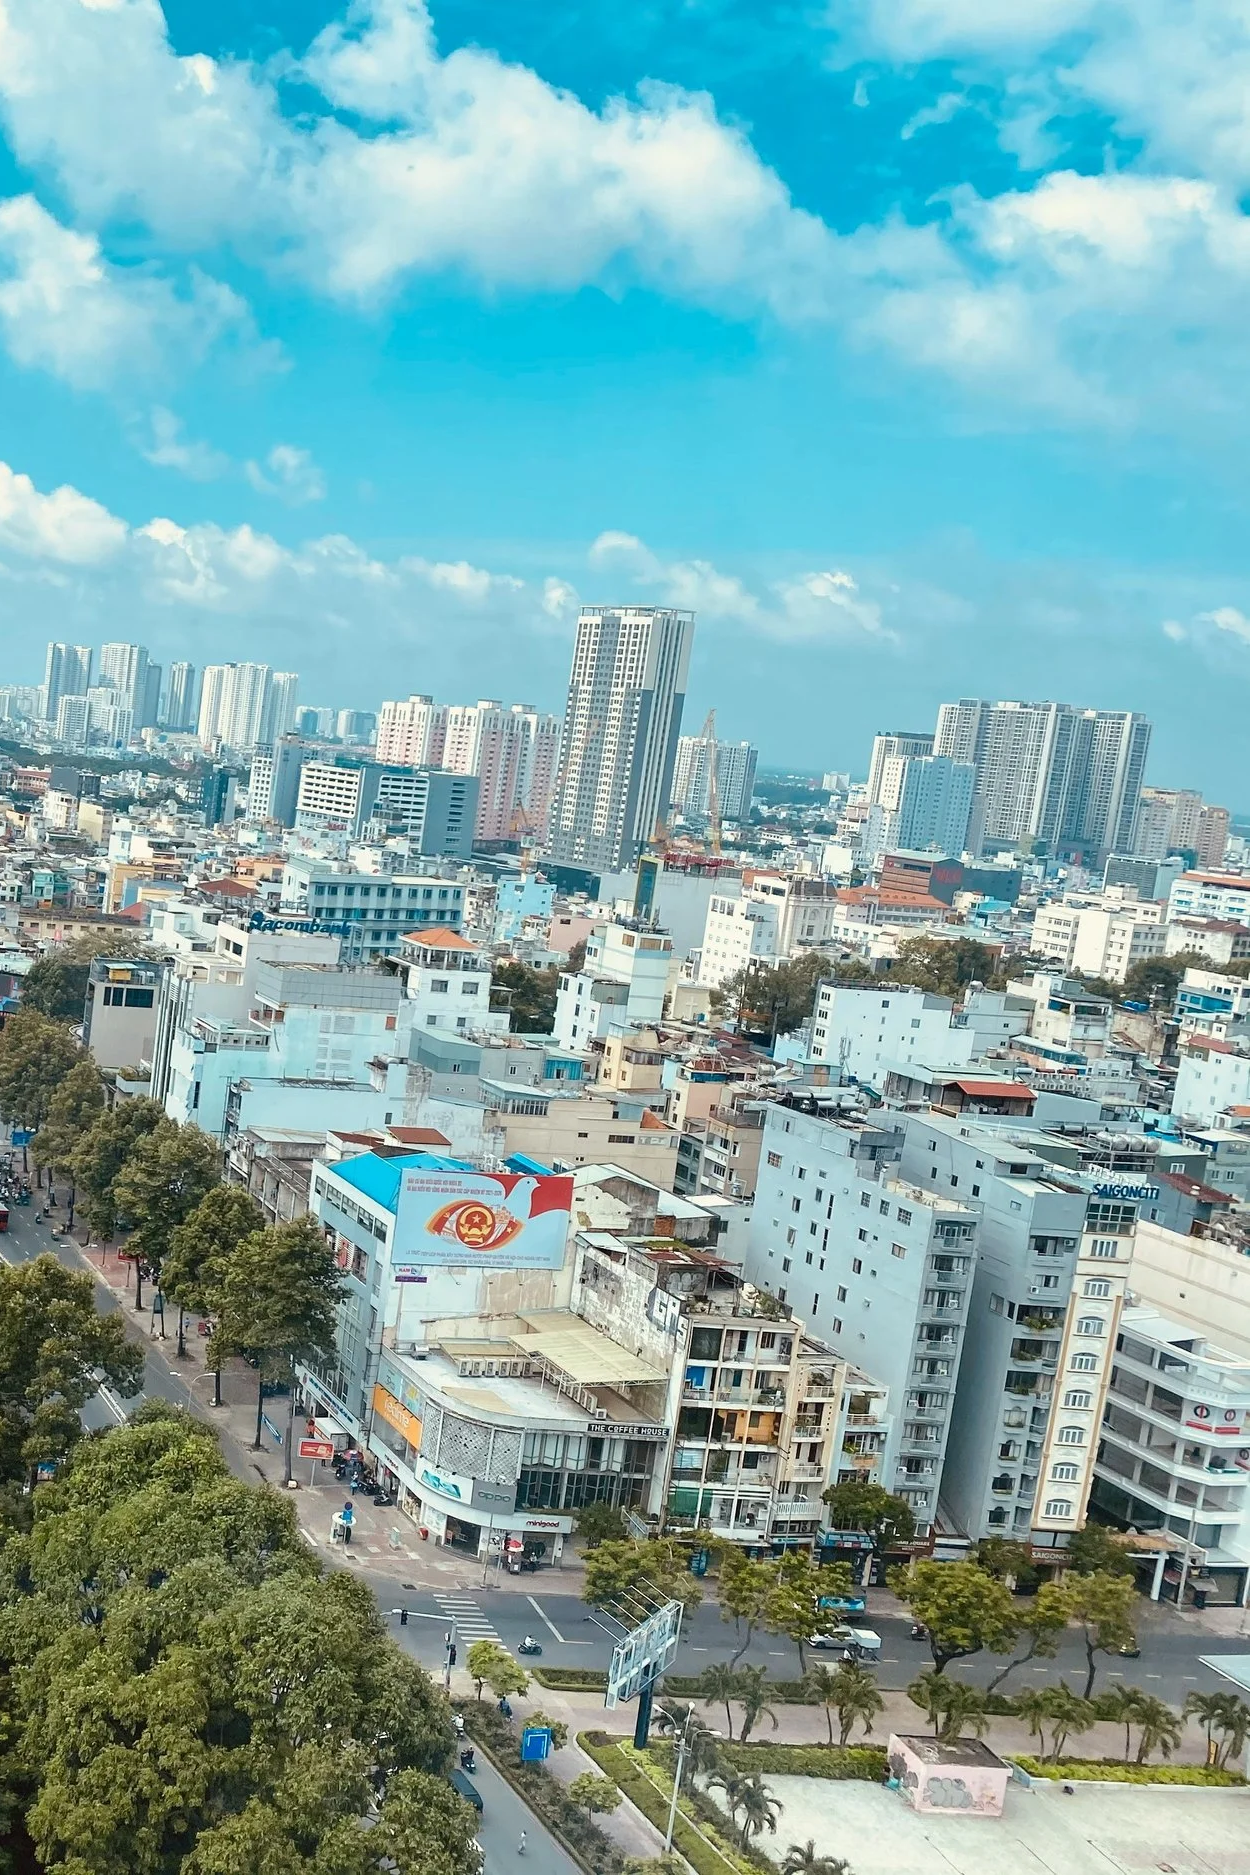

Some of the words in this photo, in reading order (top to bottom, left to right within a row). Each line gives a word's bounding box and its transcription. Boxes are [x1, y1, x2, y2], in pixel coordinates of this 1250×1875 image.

[385, 1398, 410, 1428] realme
[591, 1424, 606, 1432] THE
[607, 1425, 639, 1434] COFFEE
[641, 1428, 668, 1436] HOUSE
[526, 1519, 560, 1529] minigood
